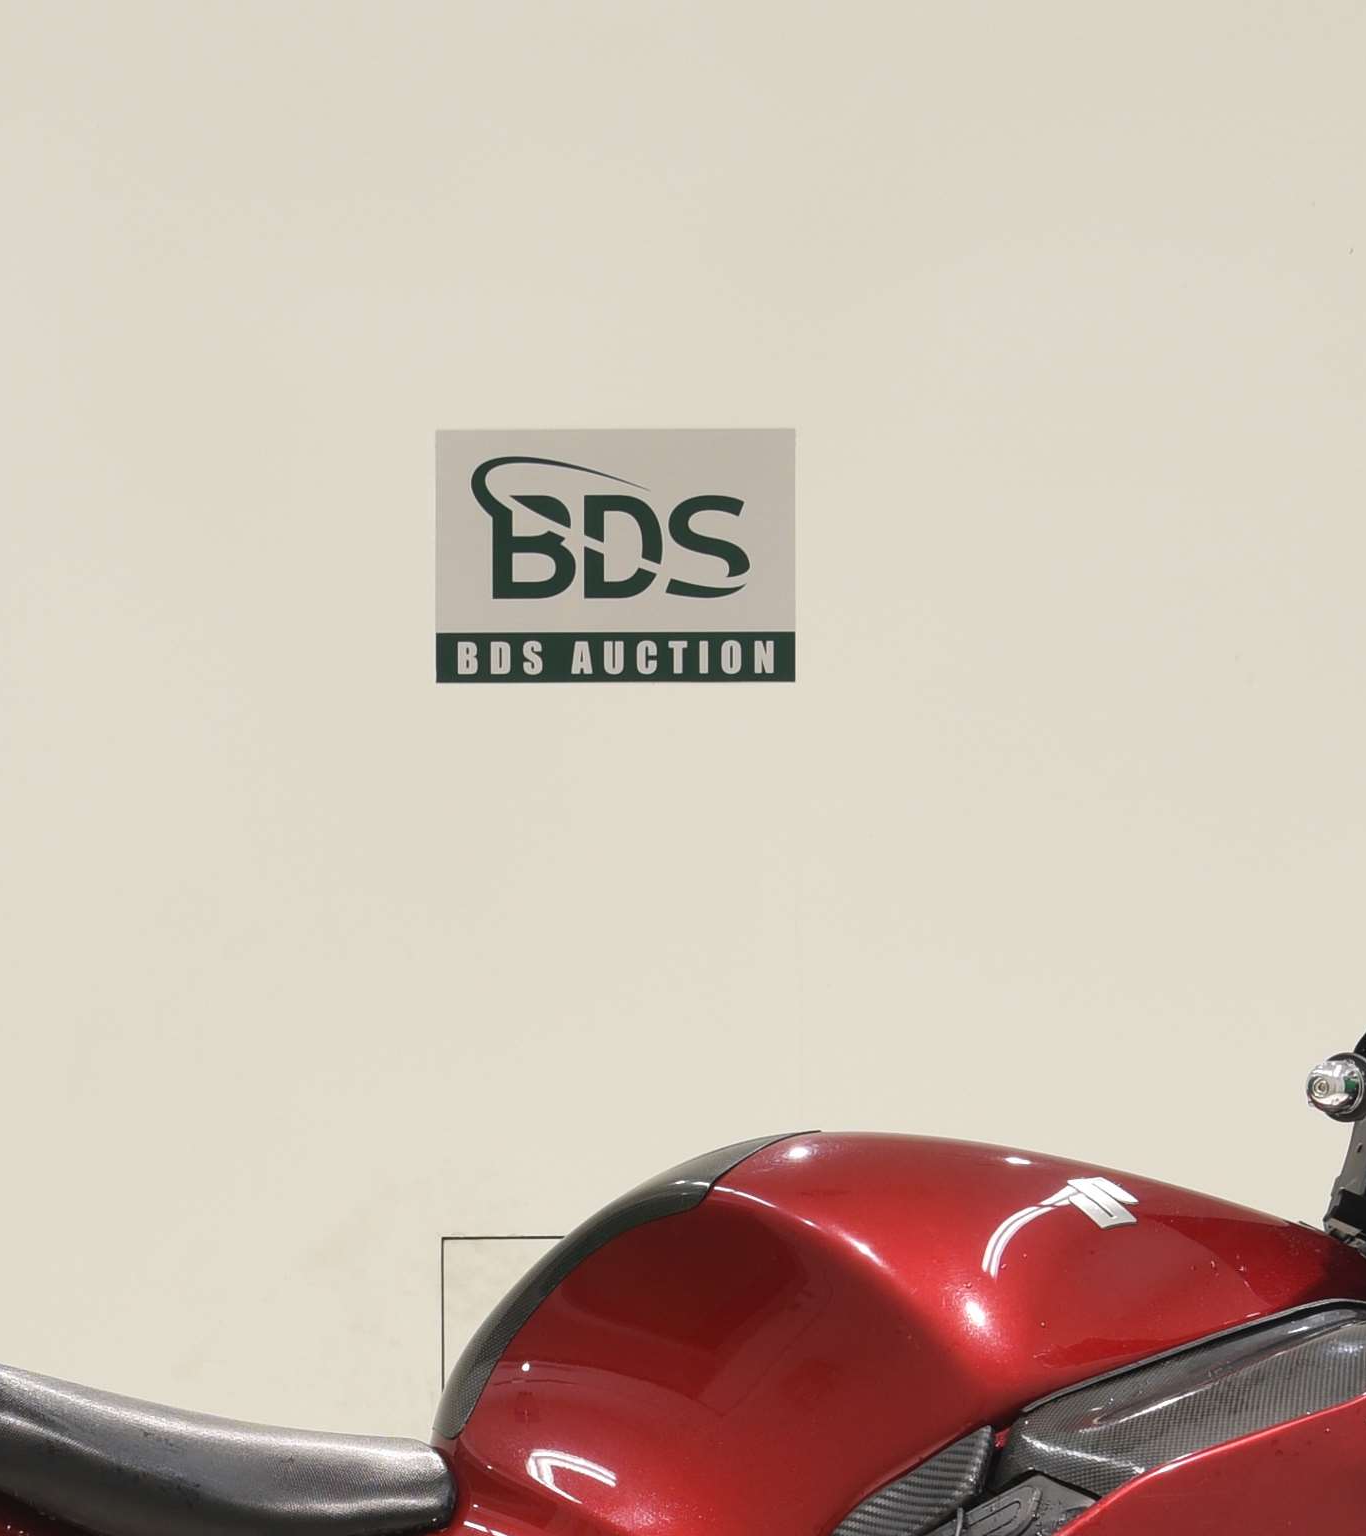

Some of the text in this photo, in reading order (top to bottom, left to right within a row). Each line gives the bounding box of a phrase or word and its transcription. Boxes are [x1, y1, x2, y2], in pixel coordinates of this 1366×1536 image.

[471, 456, 751, 599] BDS
[457, 640, 775, 675] BDS AUCTION
